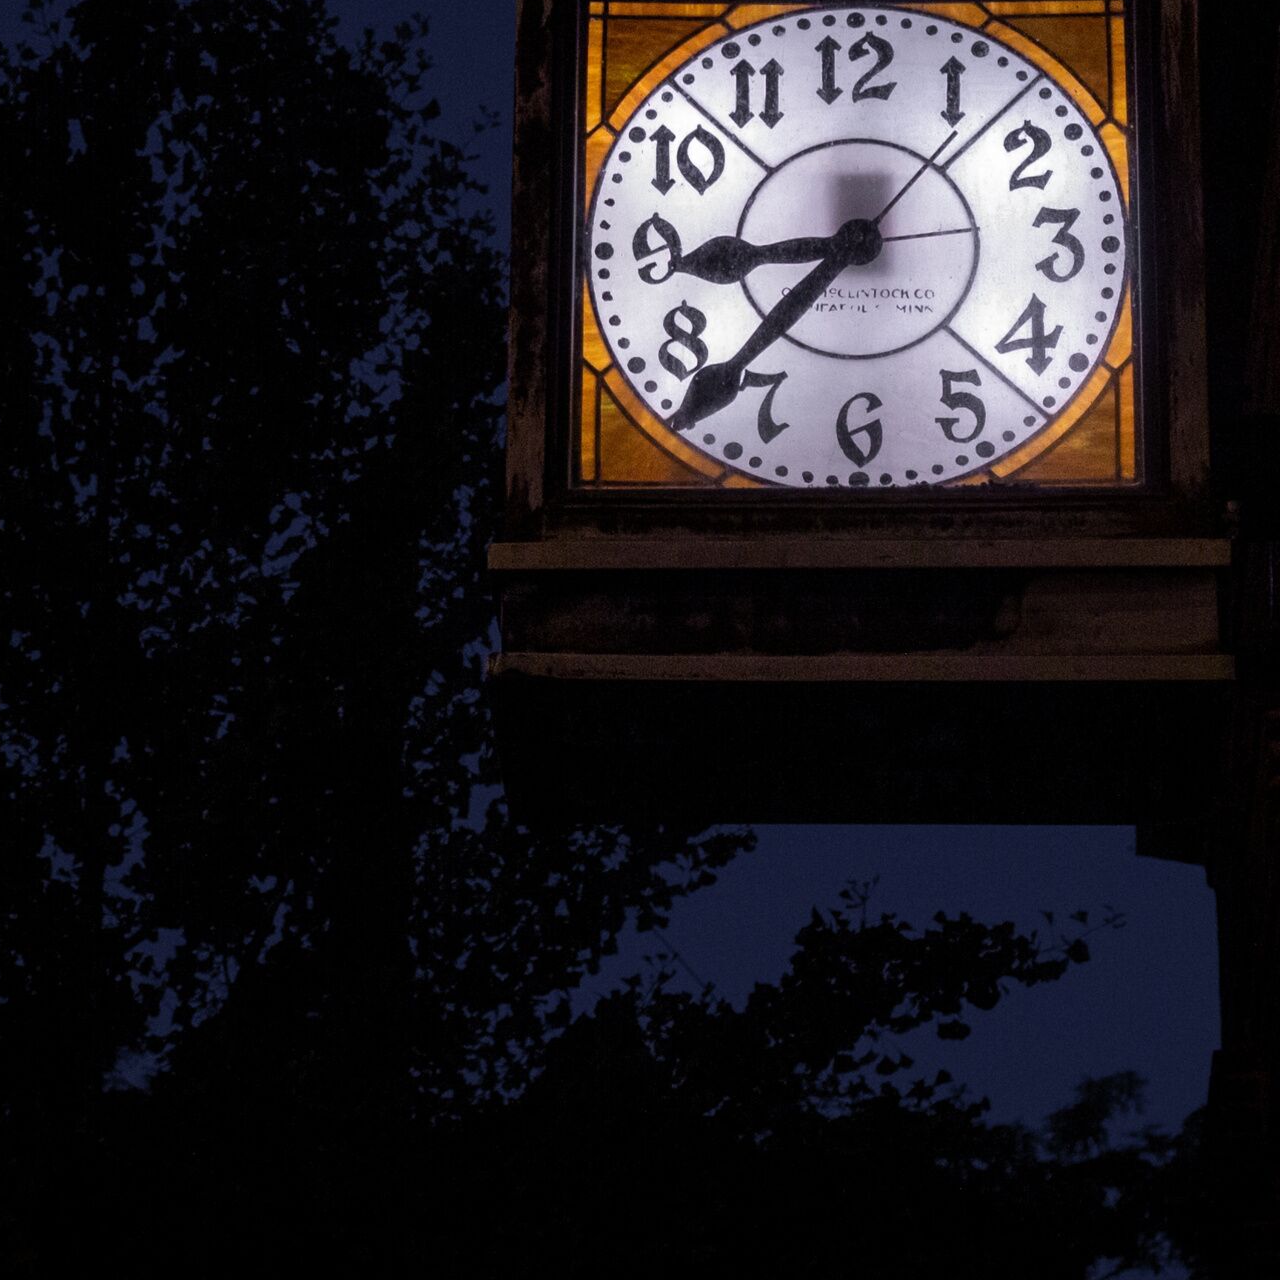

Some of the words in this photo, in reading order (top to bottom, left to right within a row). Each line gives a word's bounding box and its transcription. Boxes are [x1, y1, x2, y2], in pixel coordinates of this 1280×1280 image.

[729, 57, 784, 129] 11
[815, 31, 898, 105] 12
[940, 56, 966, 127] 1
[649, 123, 726, 196] 10
[1002, 119, 1054, 192] 2
[632, 212, 682, 285] 9
[1032, 206, 1085, 282] 3
[658, 299, 709, 379] 8
[994, 292, 1064, 376] 4
[740, 369, 789, 445] 7
[835, 391, 884, 468] 6
[935, 368, 986, 444] 5
